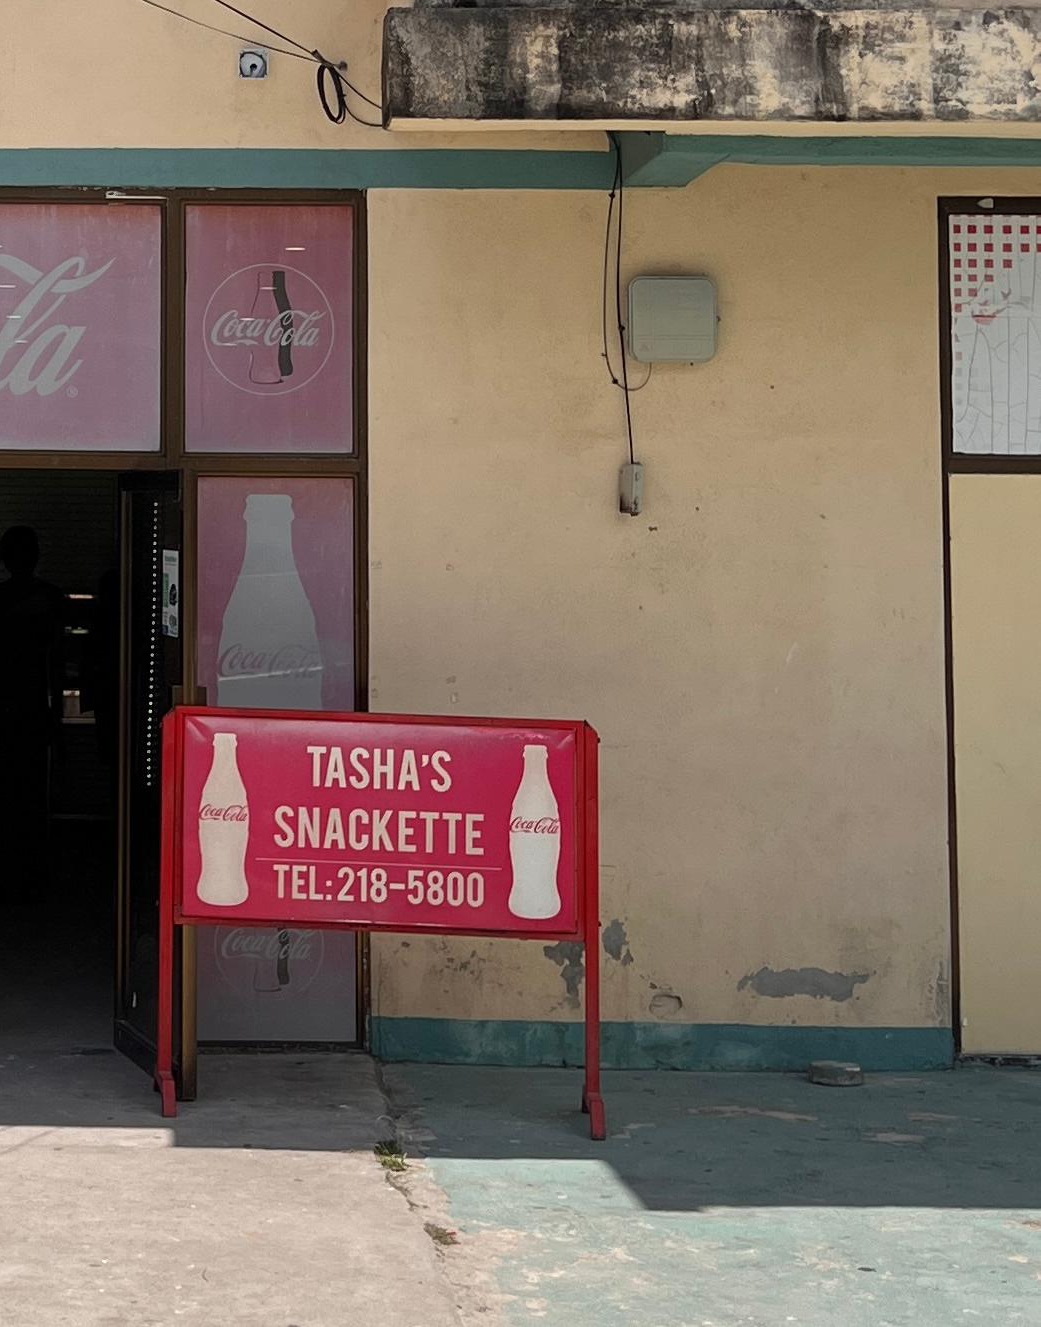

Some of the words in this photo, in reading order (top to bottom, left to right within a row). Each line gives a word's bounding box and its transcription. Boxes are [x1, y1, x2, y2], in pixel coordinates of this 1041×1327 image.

[211, 310, 327, 347] Coca-Cola
[306, 745, 452, 792] TASHA'S
[273, 806, 484, 856] SNACKETTE
[273, 864, 484, 908] TEL:218-5800
